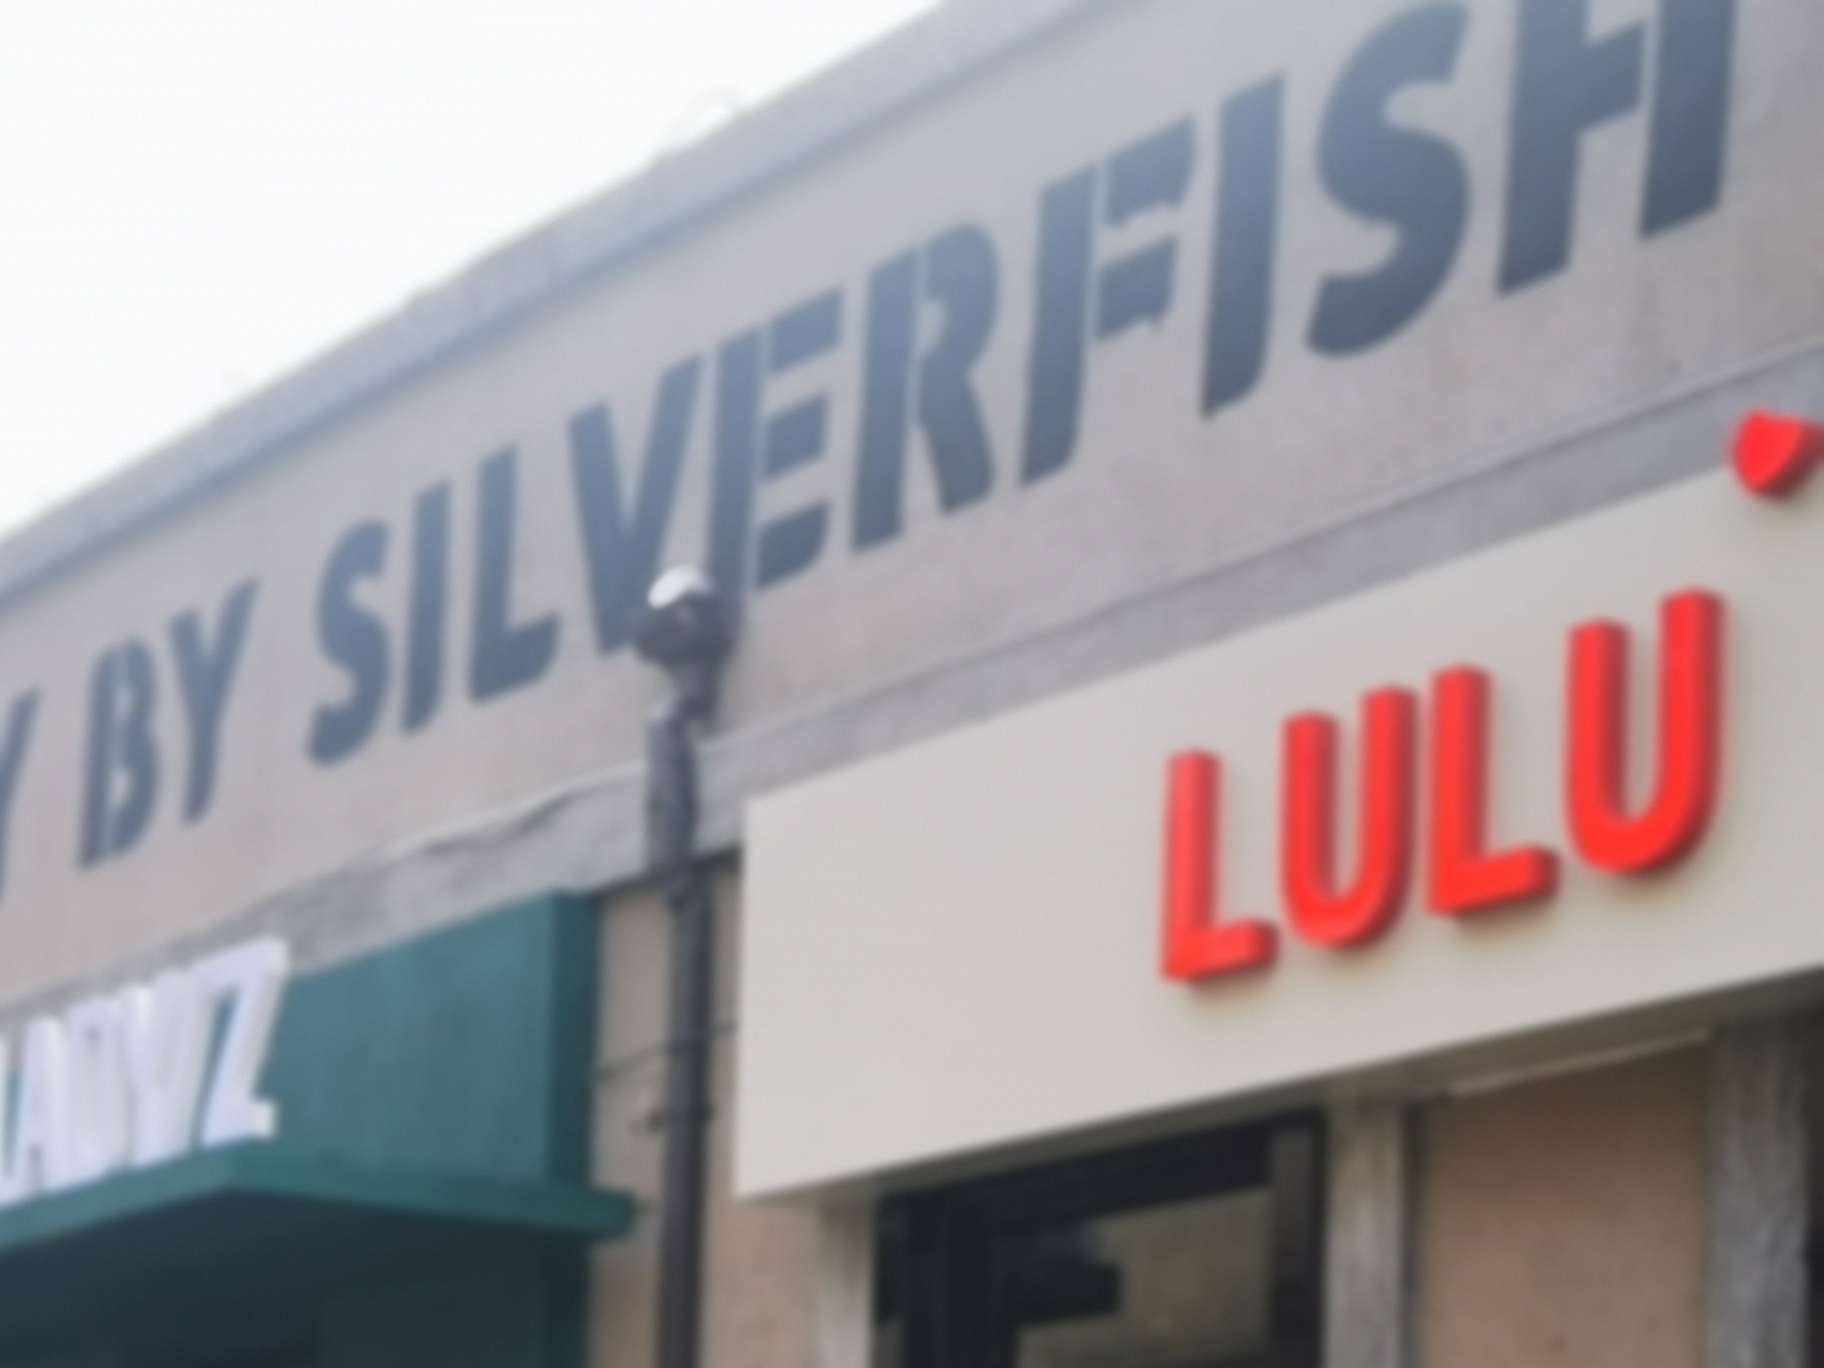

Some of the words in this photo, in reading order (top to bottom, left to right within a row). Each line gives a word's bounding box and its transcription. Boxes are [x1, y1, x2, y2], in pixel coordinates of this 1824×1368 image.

[78, 576, 260, 868] BY
[307, 0, 1736, 766] SILVERFISH
[1162, 586, 1727, 982] LULU
